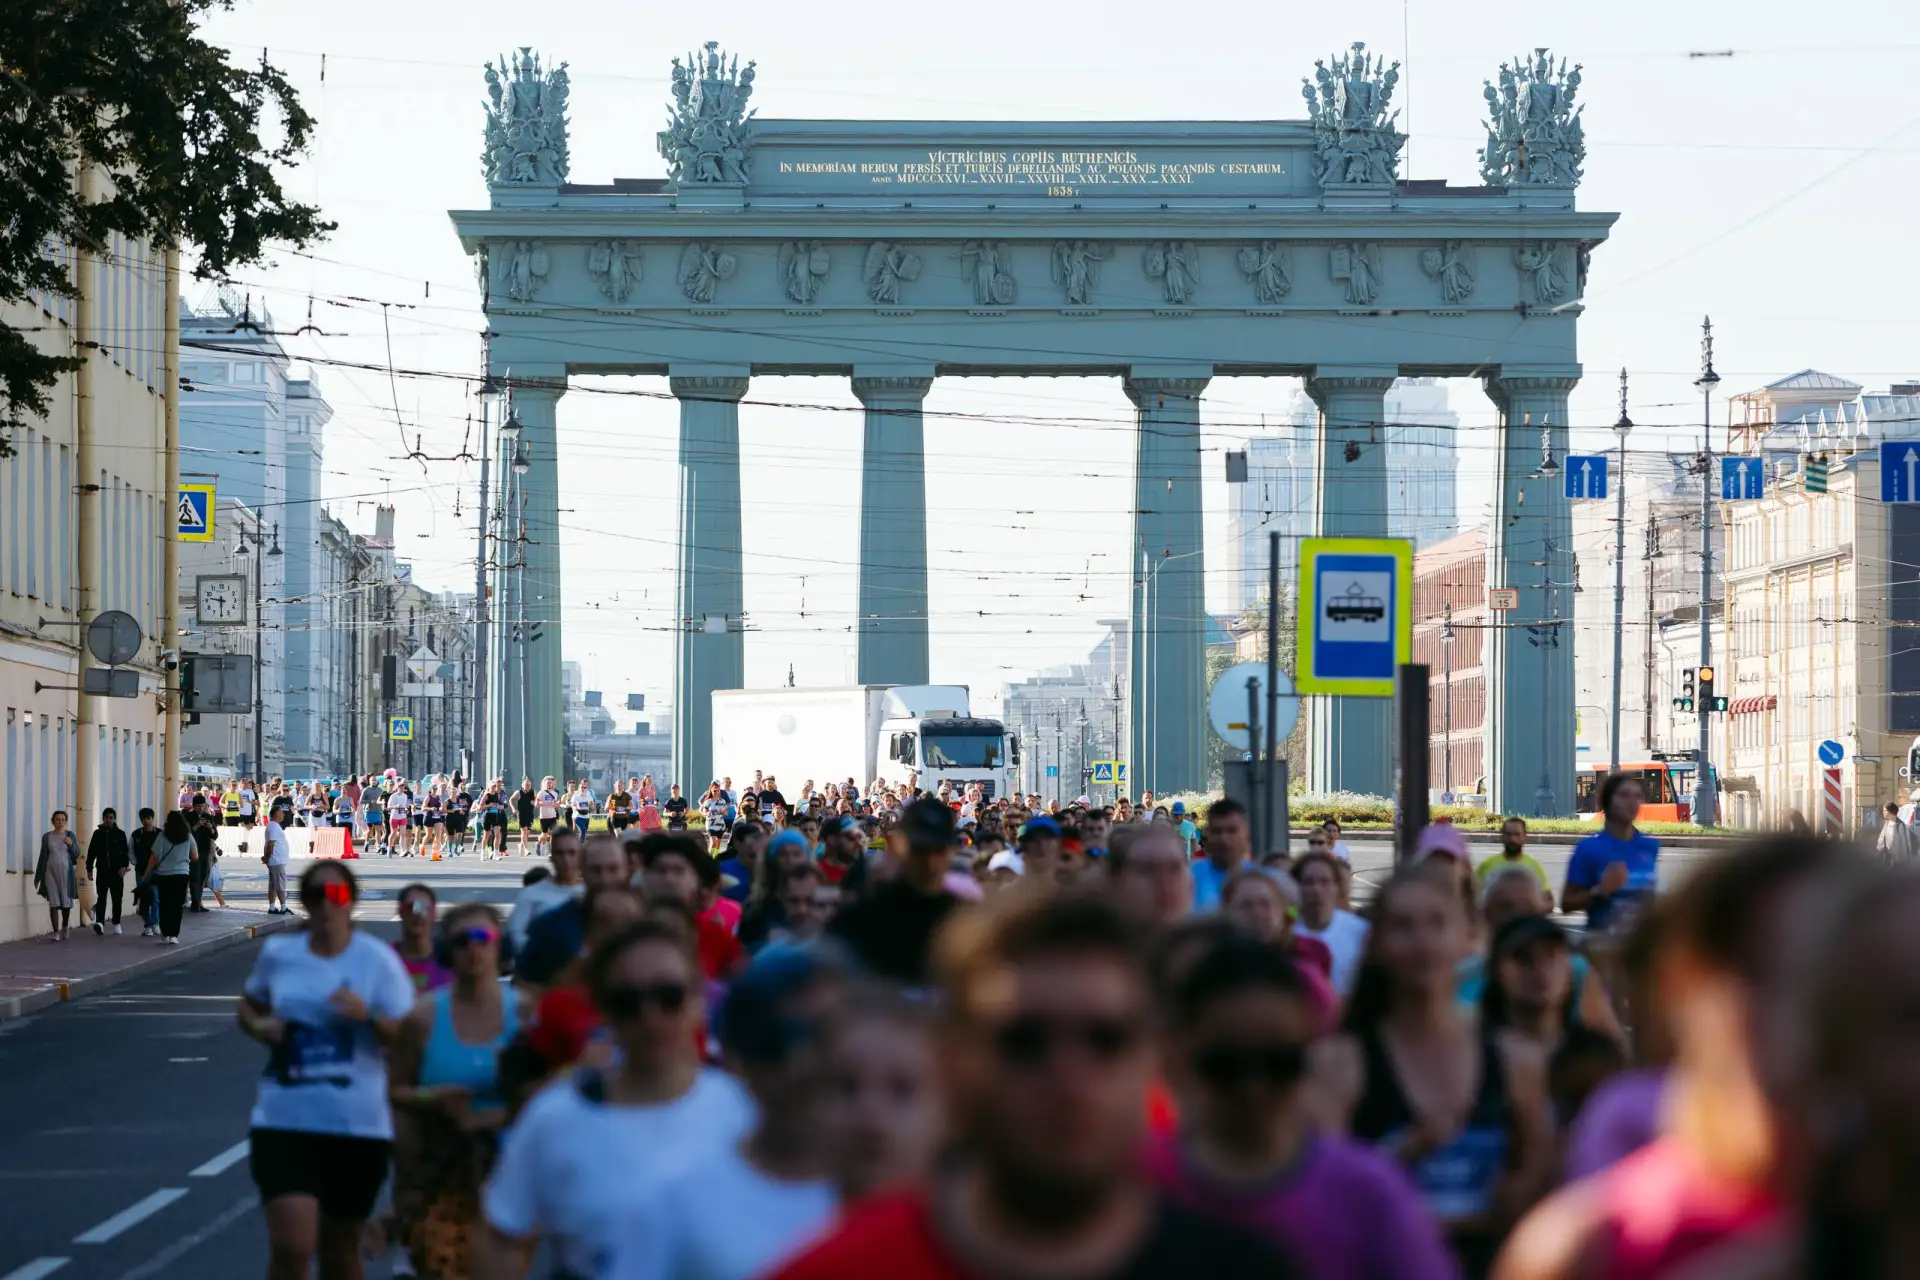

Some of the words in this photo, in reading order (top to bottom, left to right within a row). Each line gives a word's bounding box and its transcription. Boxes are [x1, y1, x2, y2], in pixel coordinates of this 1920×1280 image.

[928, 151, 1006, 164] VICTRICIBUS
[1012, 151, 1056, 164] COPIIS
[1061, 151, 1138, 164] RUTHENICIS
[780, 161, 792, 173] IN
[796, 162, 856, 173] MEMORIAM
[861, 163, 898, 173] RERUM
[903, 162, 942, 174] PERSIS
[946, 163, 960, 173] ET
[963, 162, 1004, 174] TURCIS
[1008, 162, 1082, 174] DEBELLANDIS
[1087, 164, 1102, 173] AC
[1108, 162, 1157, 174] POLONIS
[1160, 162, 1216, 174] PACANDIS
[1048, 186, 1073, 196] 1838
[1497, 599, 1510, 608] 15
